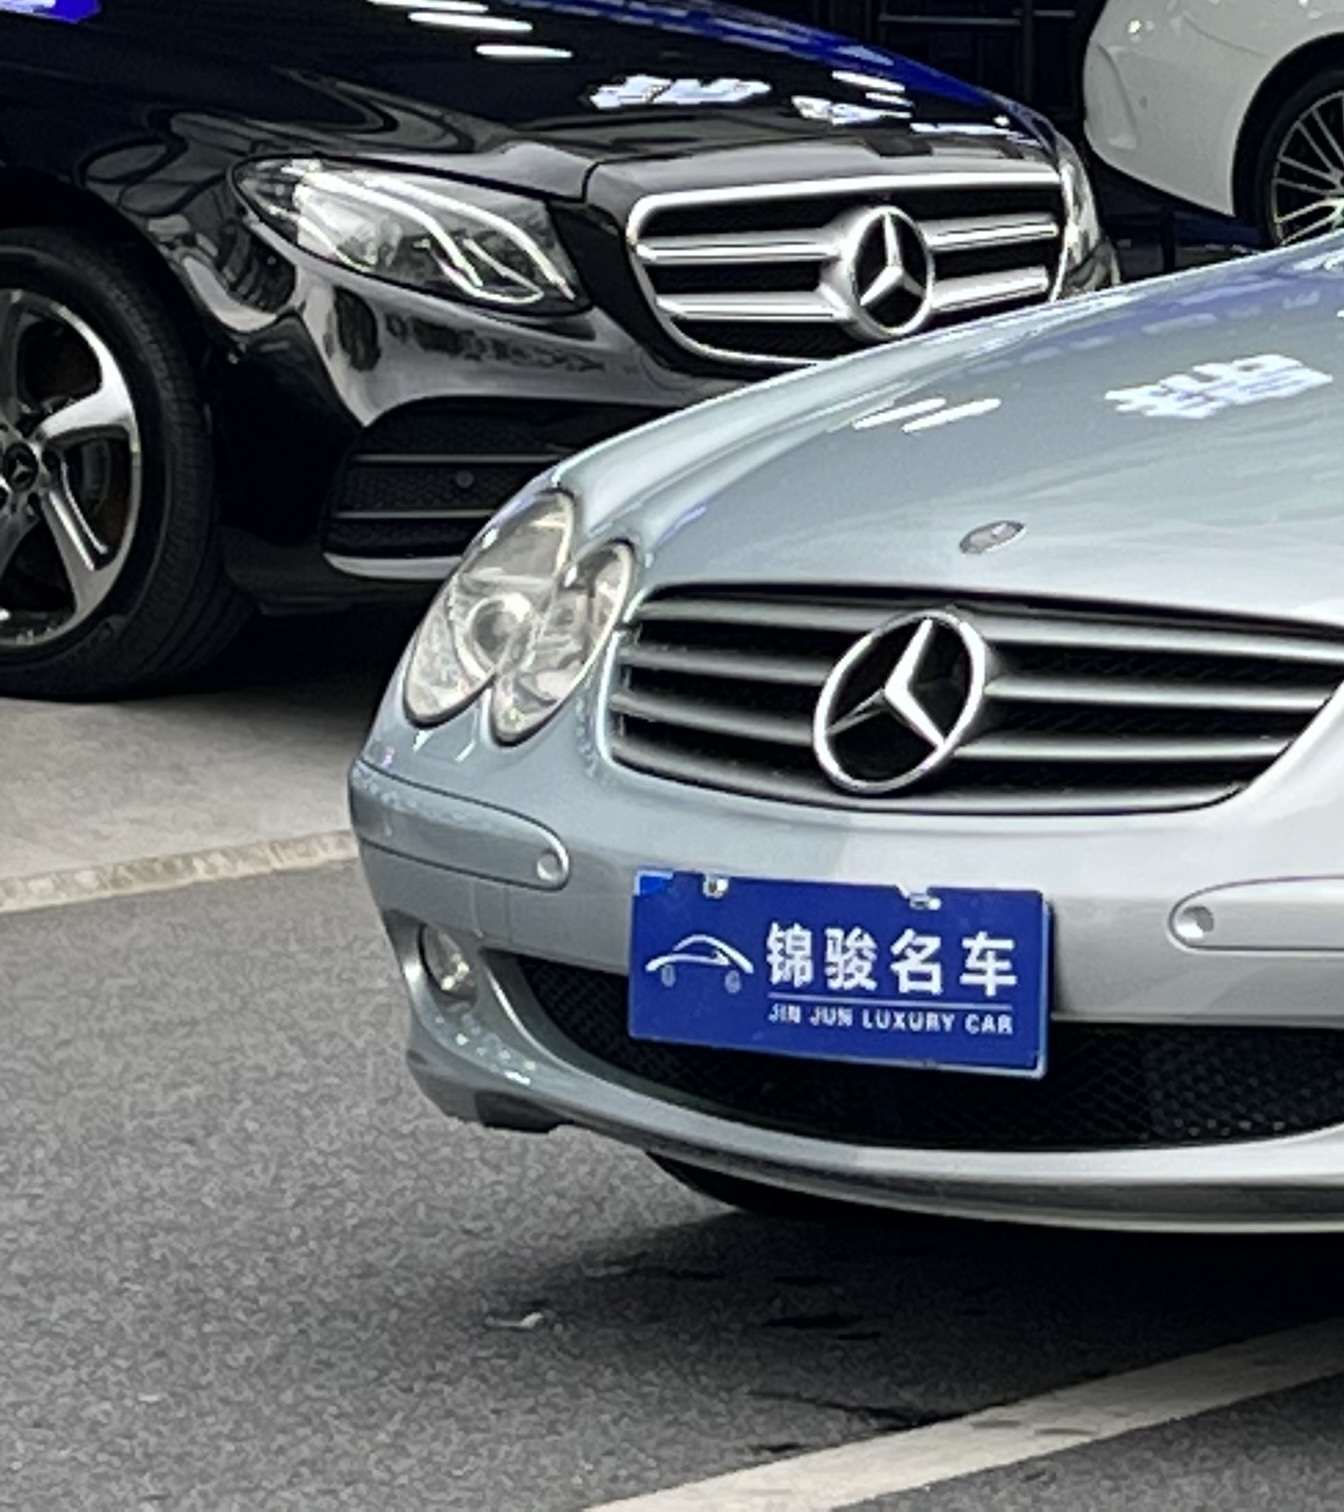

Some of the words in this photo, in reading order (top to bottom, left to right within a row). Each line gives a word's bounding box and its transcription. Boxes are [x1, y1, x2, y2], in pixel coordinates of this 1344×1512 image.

[766, 922, 1018, 997] 锦骏名车
[768, 1003, 801, 1025] JIN
[809, 1006, 854, 1027] JUN
[861, 1009, 956, 1033] LUXURY
[964, 1014, 1014, 1035] CAR
